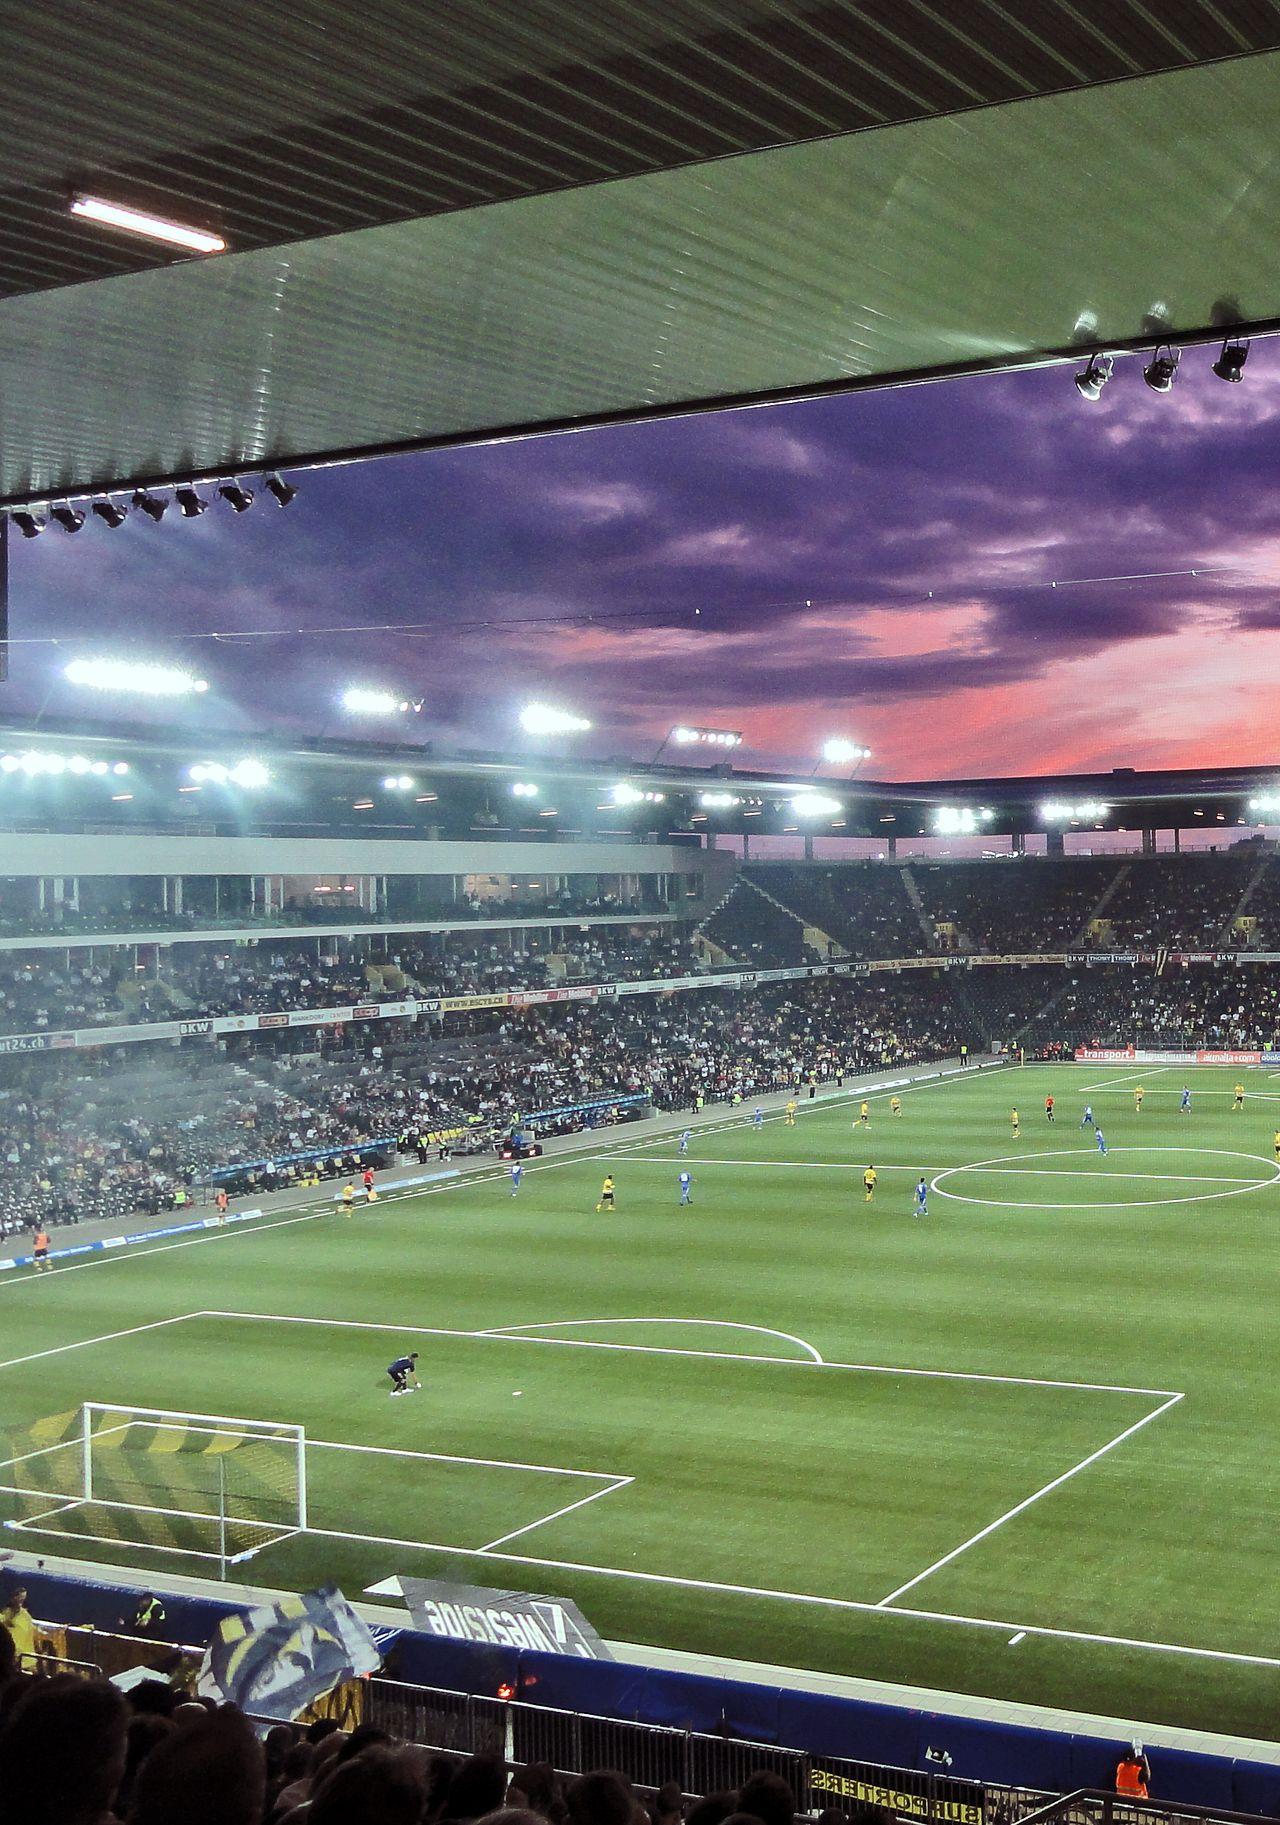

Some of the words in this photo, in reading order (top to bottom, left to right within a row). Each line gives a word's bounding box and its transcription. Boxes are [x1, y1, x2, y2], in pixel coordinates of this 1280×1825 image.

[597, 986, 615, 995] BKW
[416, 1001, 438, 1012] BKW
[180, 1021, 209, 1034] BKW
[1084, 1049, 1130, 1060] transport
